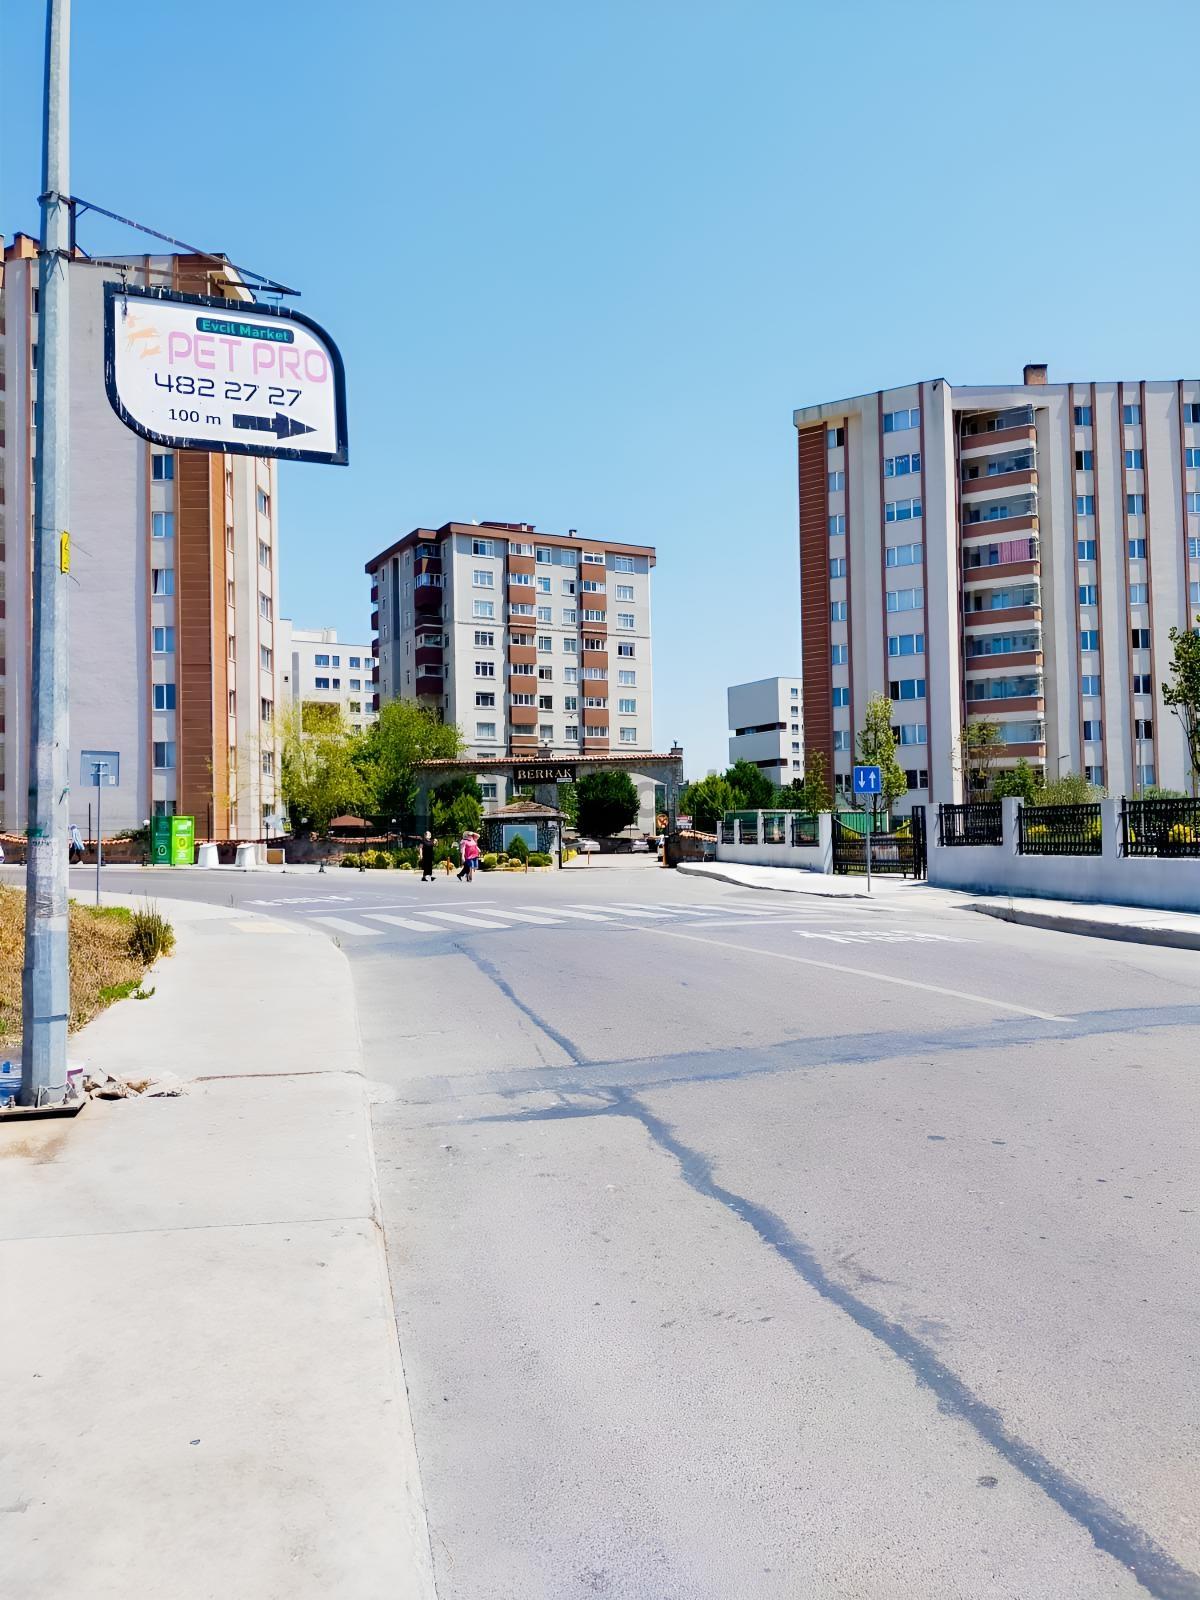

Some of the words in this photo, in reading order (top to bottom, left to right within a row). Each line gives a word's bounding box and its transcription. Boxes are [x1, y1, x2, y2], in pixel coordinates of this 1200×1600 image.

[201, 319, 236, 335] Evcil
[239, 324, 289, 342] Market
[168, 331, 242, 372] PET
[252, 342, 328, 384] PRO
[154, 373, 215, 398] 482
[224, 381, 260, 402] 27
[268, 386, 302, 407] 27
[168, 408, 200, 423] 100
[206, 413, 222, 425] m
[517, 768, 572, 779] BERRAK
